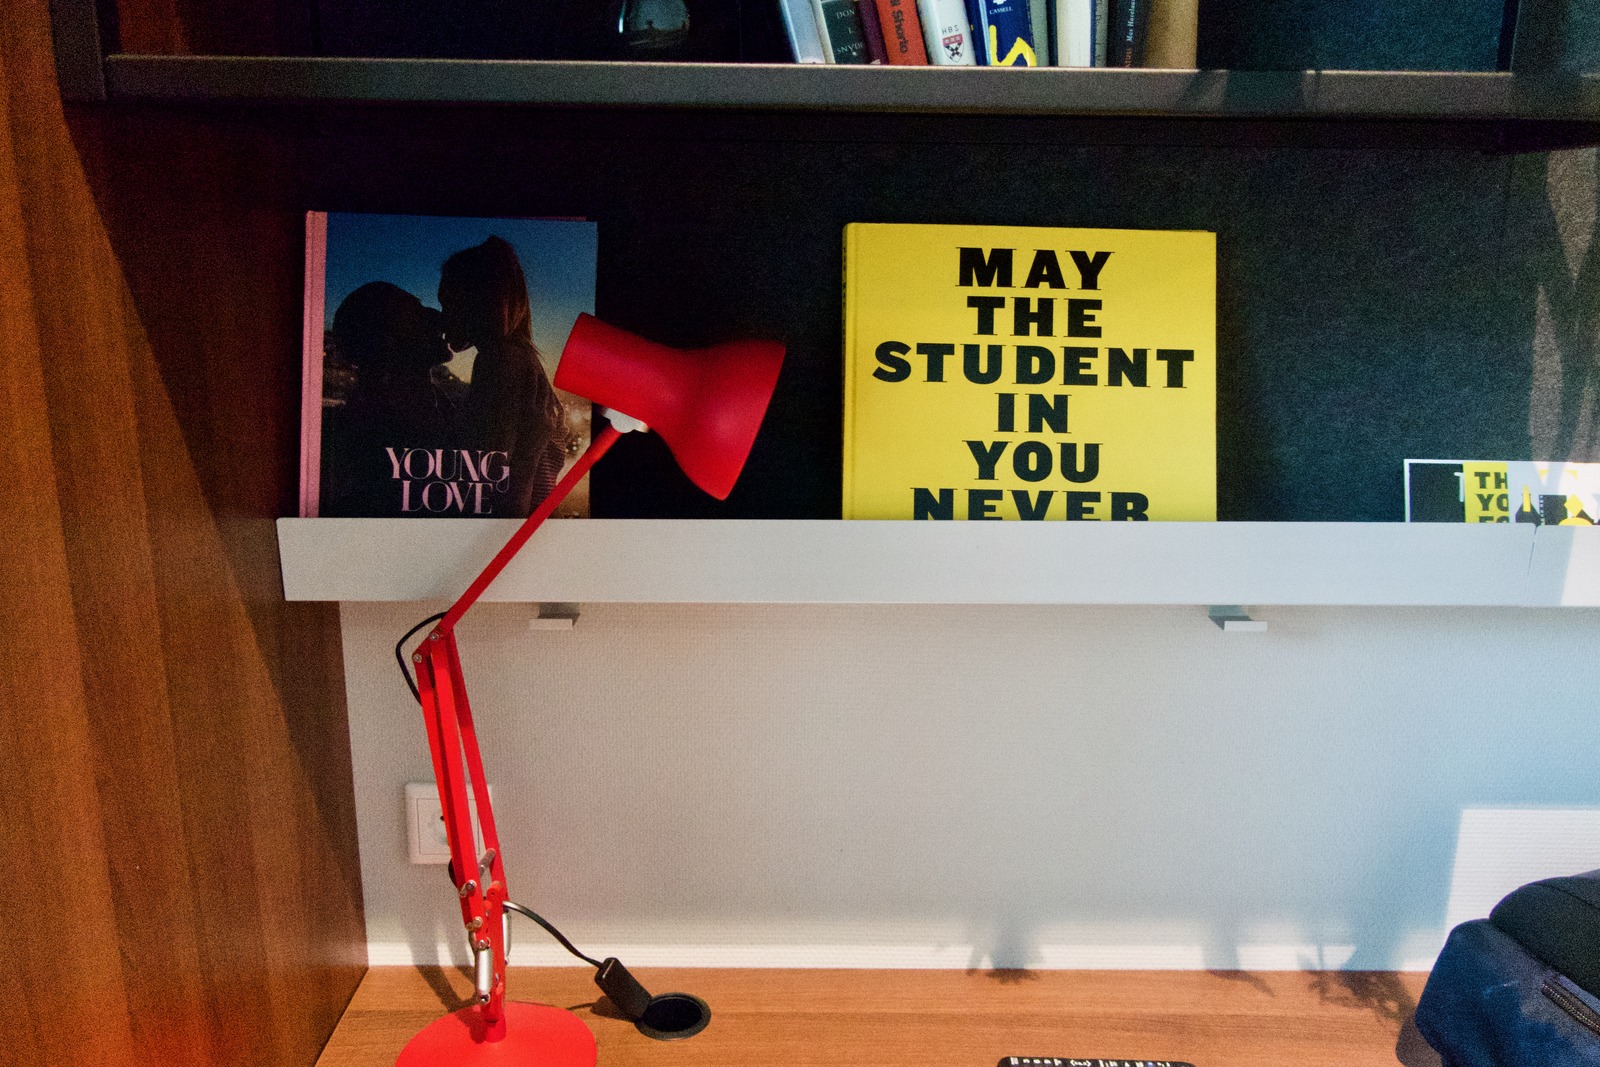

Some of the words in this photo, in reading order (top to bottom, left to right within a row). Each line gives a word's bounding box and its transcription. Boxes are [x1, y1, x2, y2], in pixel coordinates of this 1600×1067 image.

[836, 9, 855, 19] DON
[989, 6, 1013, 15] CASSELL
[955, 247, 1115, 290] MAY
[967, 296, 1102, 338] THE
[872, 340, 1194, 388] STUDENT
[994, 393, 1072, 433] IN
[385, 447, 510, 492] YOUNG
[962, 439, 1103, 483] YOU
[401, 480, 492, 514] LOVE
[910, 487, 1150, 521] NEVER
